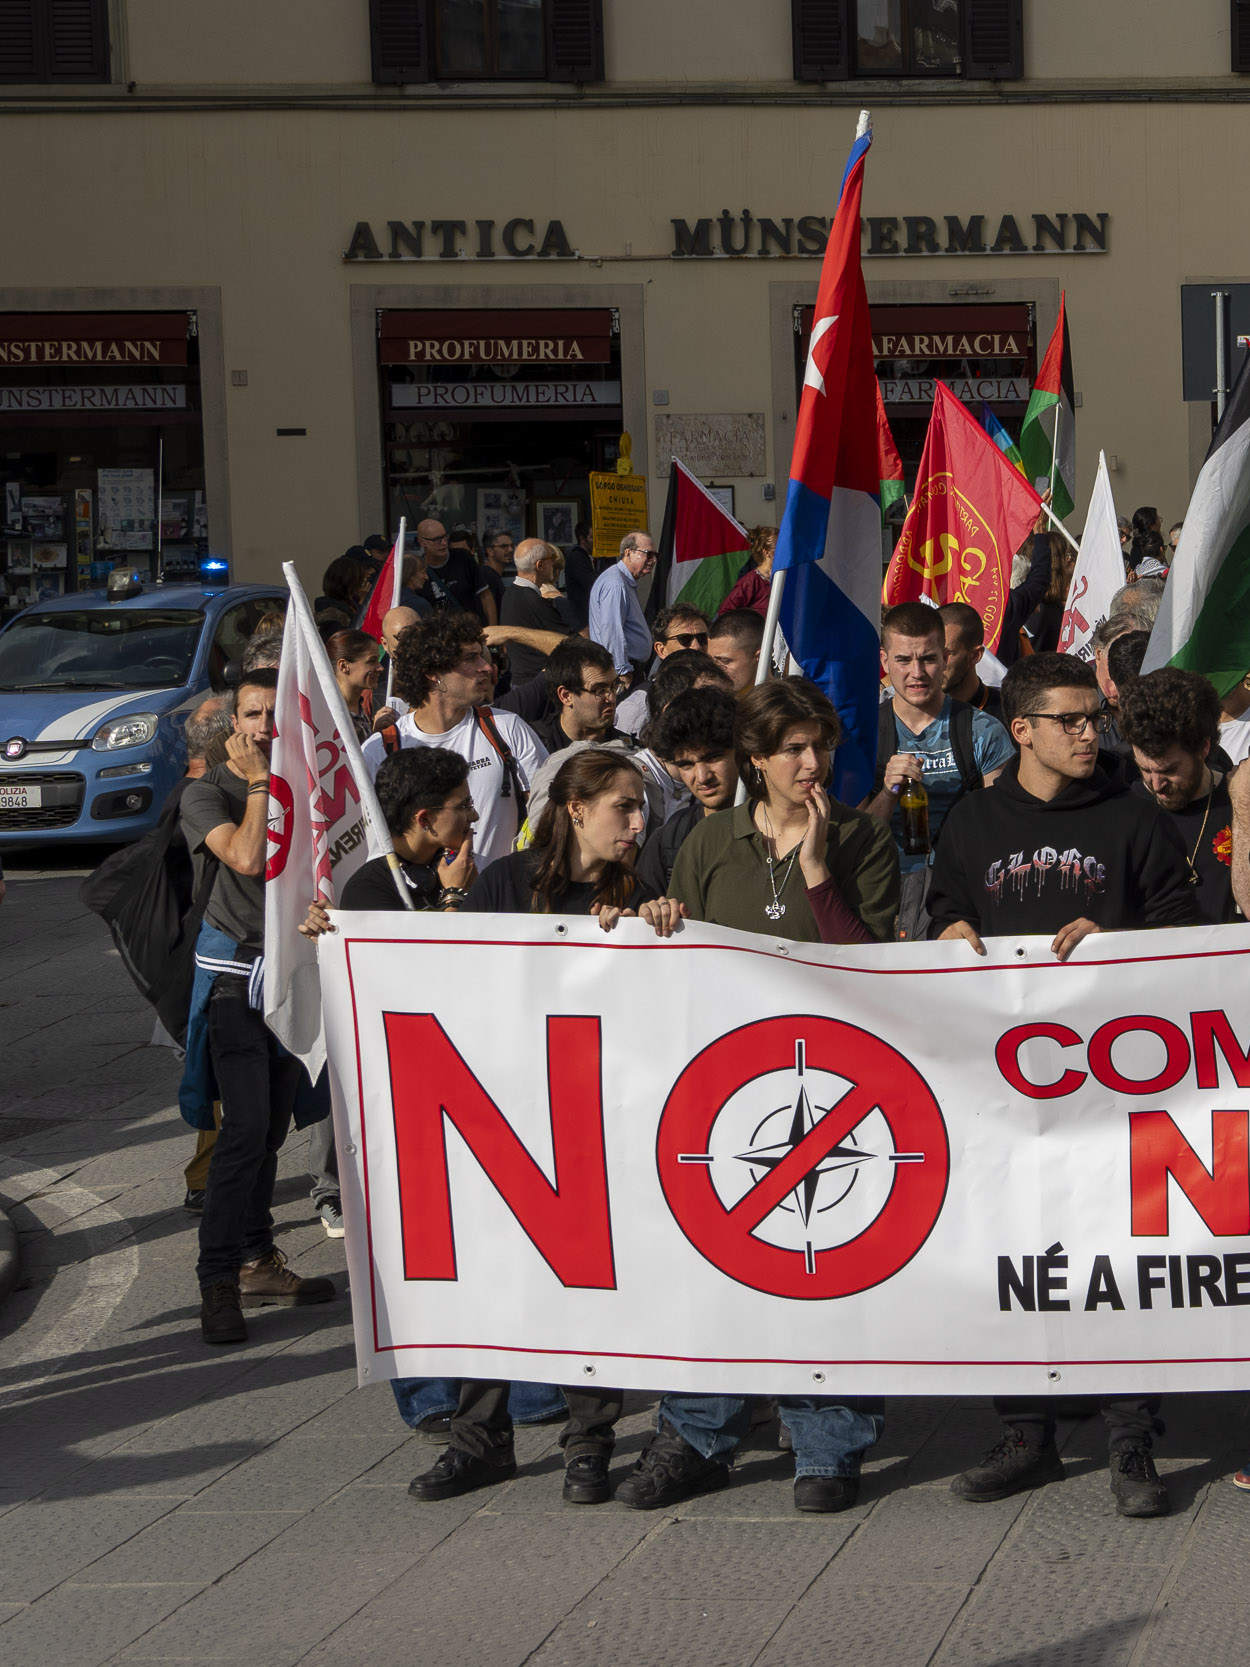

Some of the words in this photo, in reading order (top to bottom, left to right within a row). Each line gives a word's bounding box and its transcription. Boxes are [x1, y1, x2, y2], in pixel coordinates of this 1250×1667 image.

[345, 218, 576, 258] ANTICA
[670, 208, 1110, 256] MÜNSERMANN
[408, 340, 584, 360] PROFUMERIA
[416, 384, 598, 405] PROFUMERIA
[669, 430, 750, 445] FARMACIA
[1, 796, 28, 808] 9848
[999, 1242, 1069, 1312] NÉ
[1083, 1255, 1126, 1312] A
